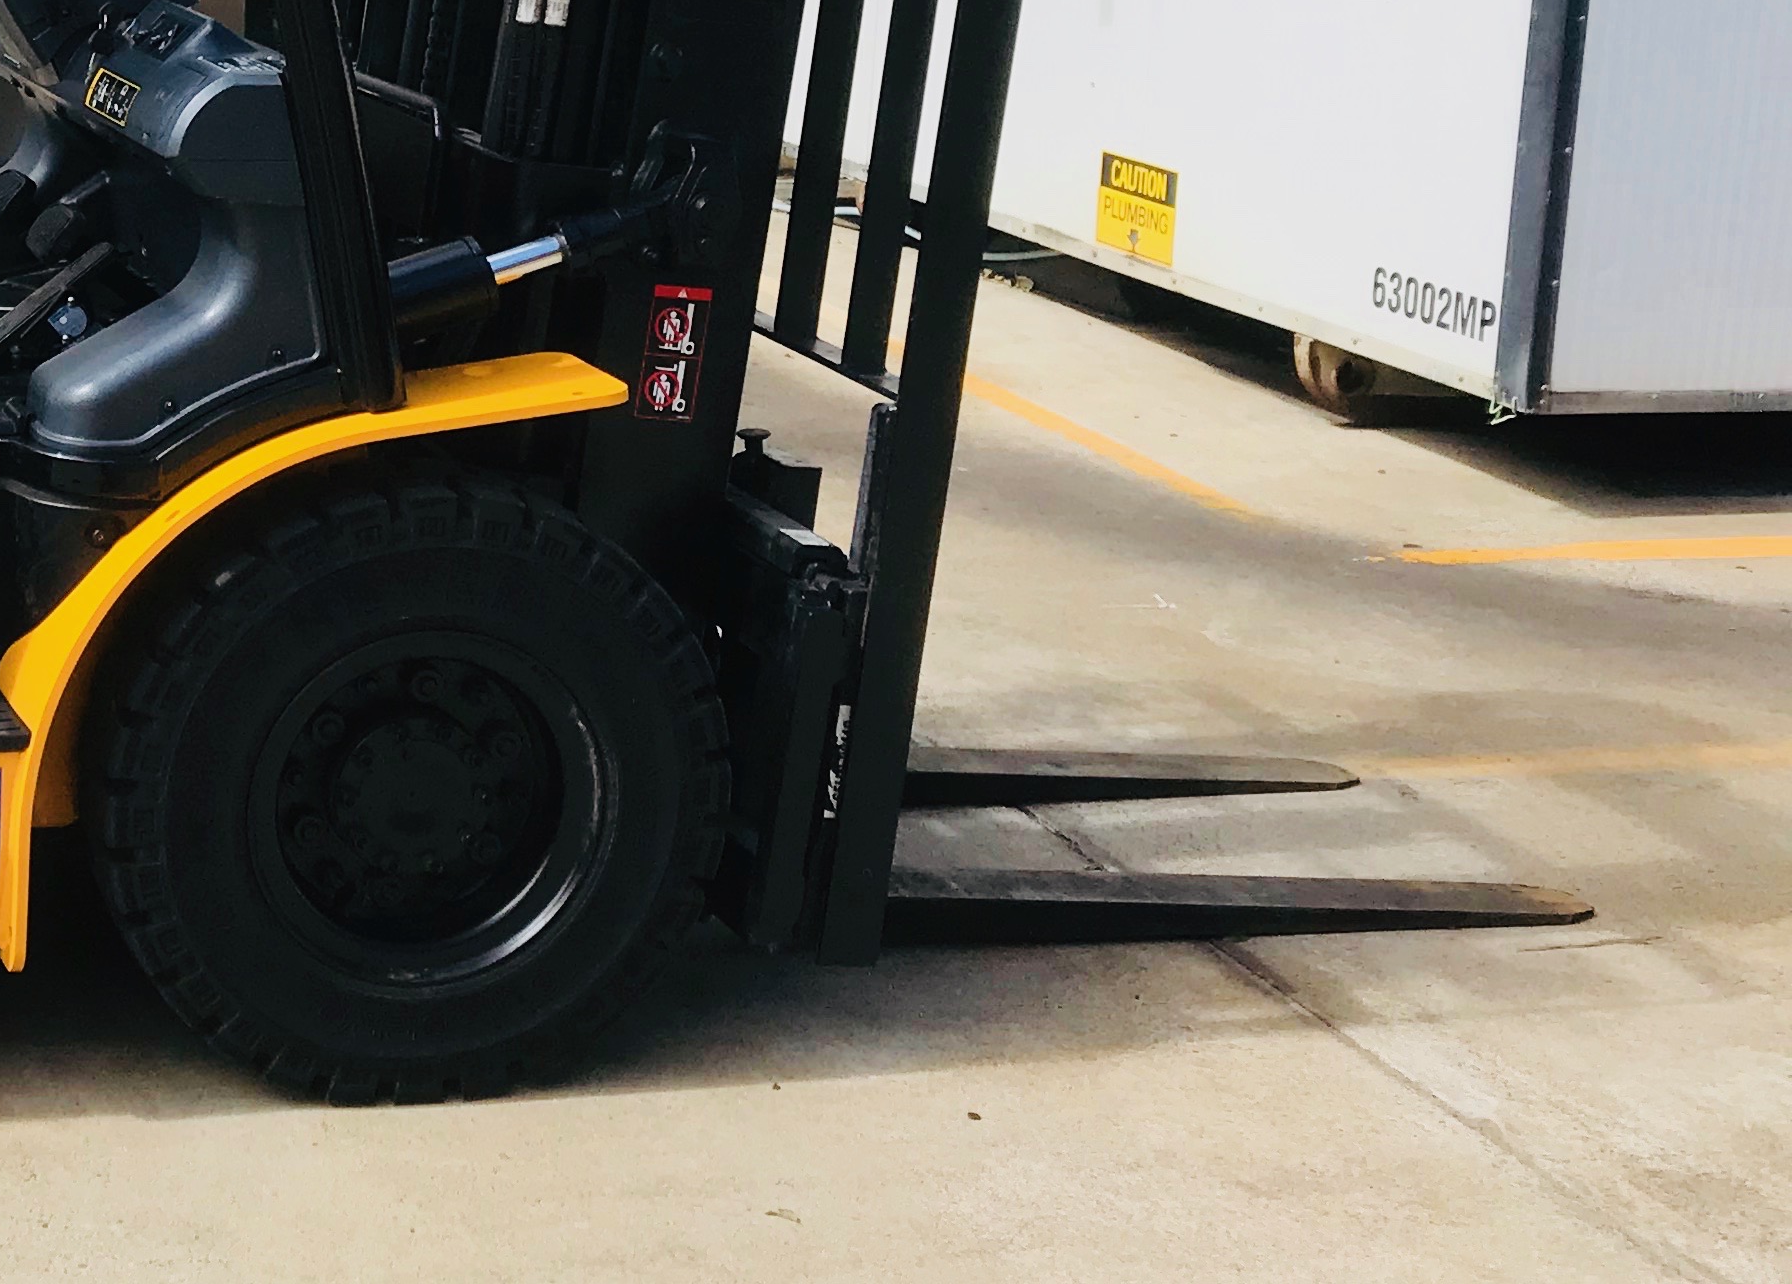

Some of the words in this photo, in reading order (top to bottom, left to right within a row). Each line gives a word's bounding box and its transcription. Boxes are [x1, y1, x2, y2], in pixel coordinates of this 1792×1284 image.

[1111, 159, 1168, 201] CAUTION
[1103, 196, 1169, 235] PLUMBING
[1372, 267, 1497, 342] 63002MP
